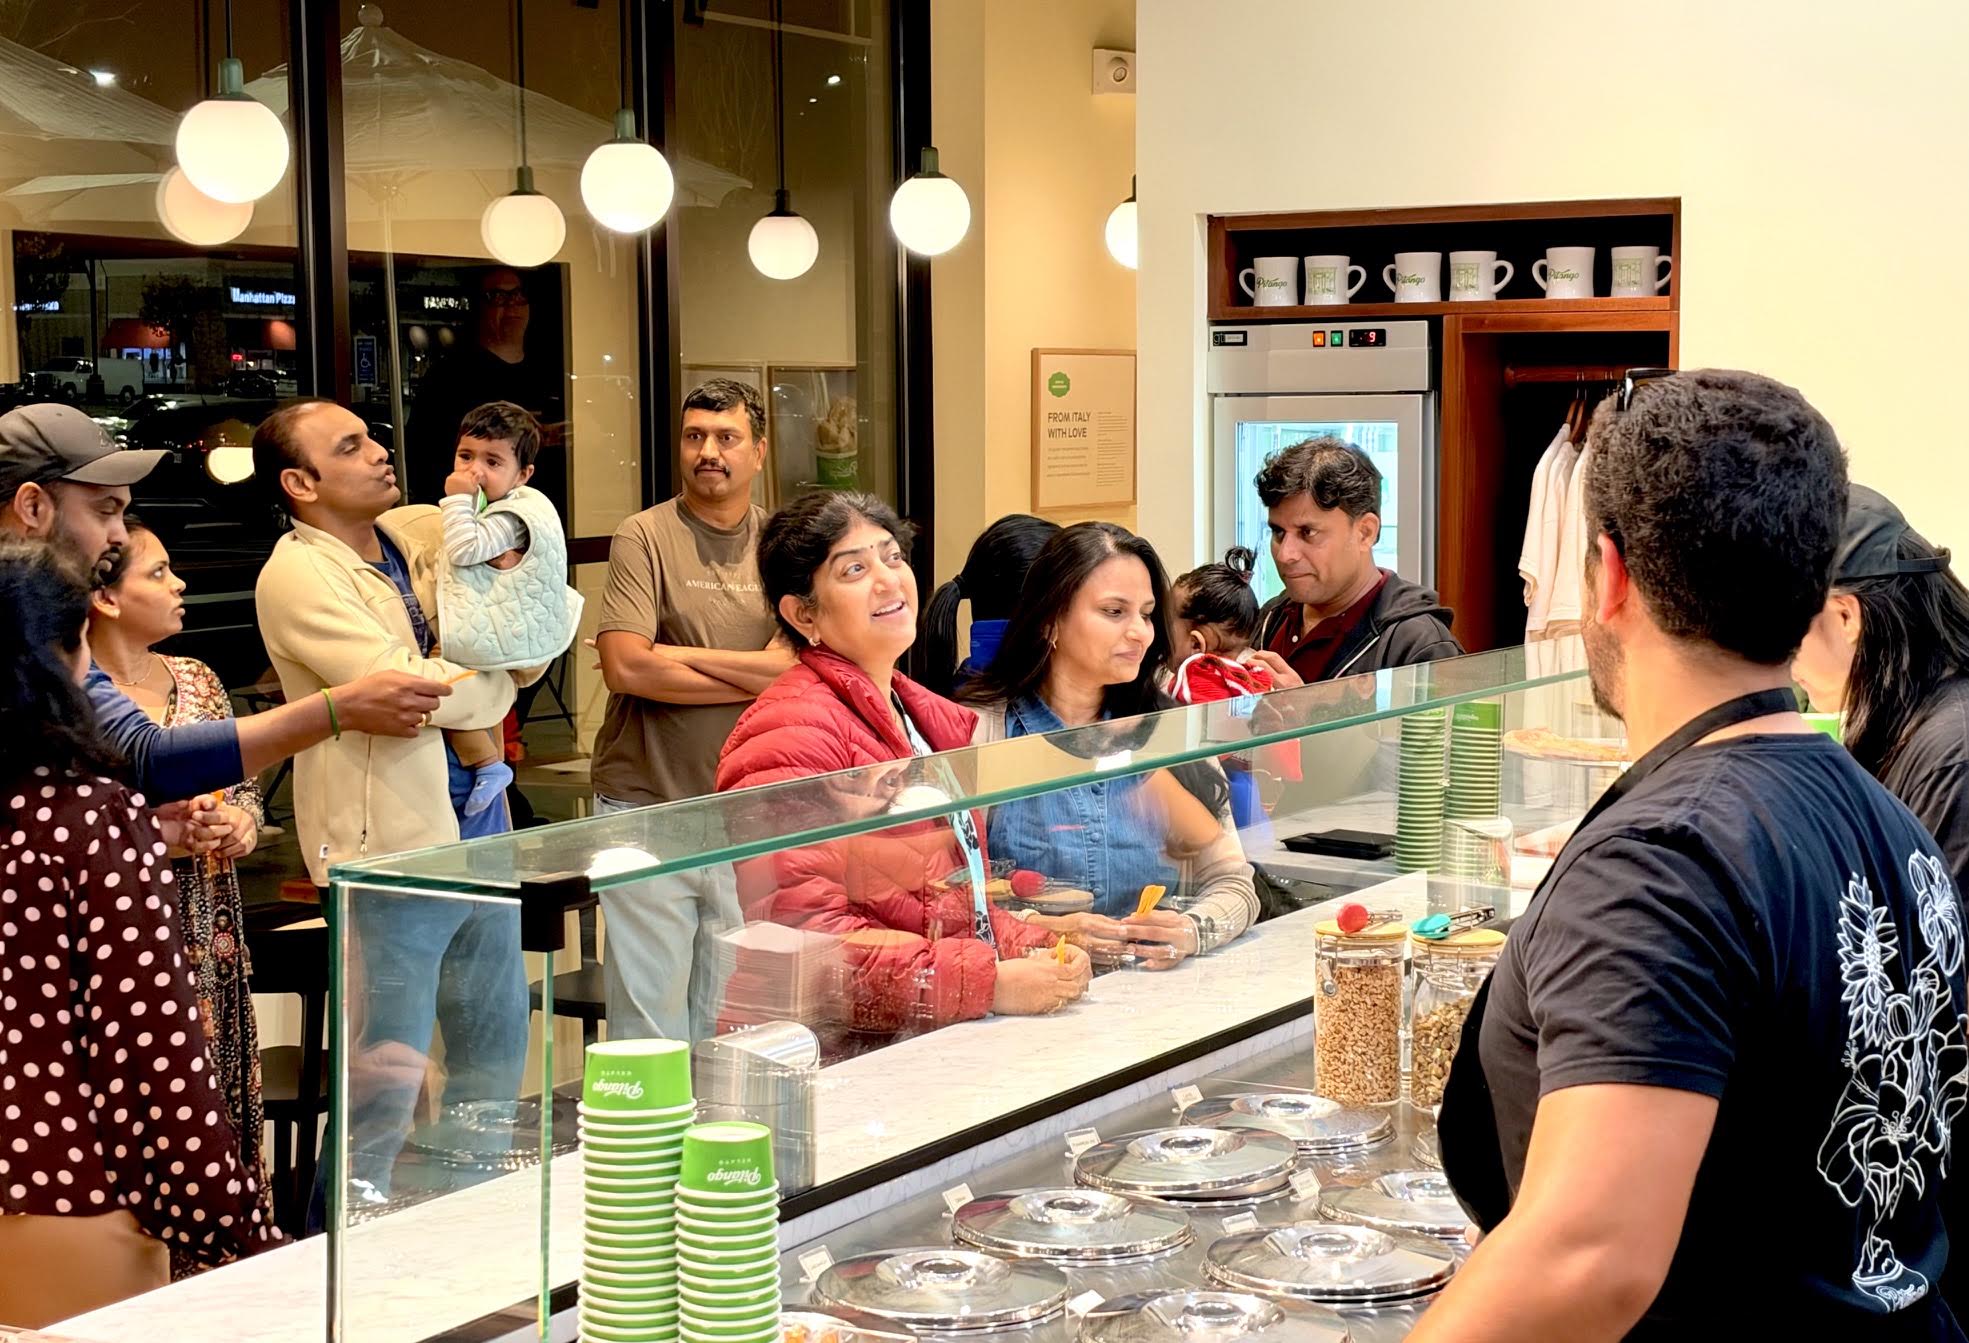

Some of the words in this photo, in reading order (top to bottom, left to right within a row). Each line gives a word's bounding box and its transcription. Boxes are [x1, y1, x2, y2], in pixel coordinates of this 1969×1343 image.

[1256, 276, 1288, 290] Pitango
[230, 286, 275, 304] Manhattan
[1369, 331, 1377, 343] 9
[1048, 411, 1071, 423] FROM
[1072, 411, 1091, 422] ITALY
[1047, 427, 1067, 438] WITH
[1068, 427, 1088, 438] LOVE
[685, 579, 735, 591] AMERICAN
[735, 583, 761, 593] EAGL
[592, 1078, 644, 1099] Pitango
[707, 1166, 761, 1186] Pitango
